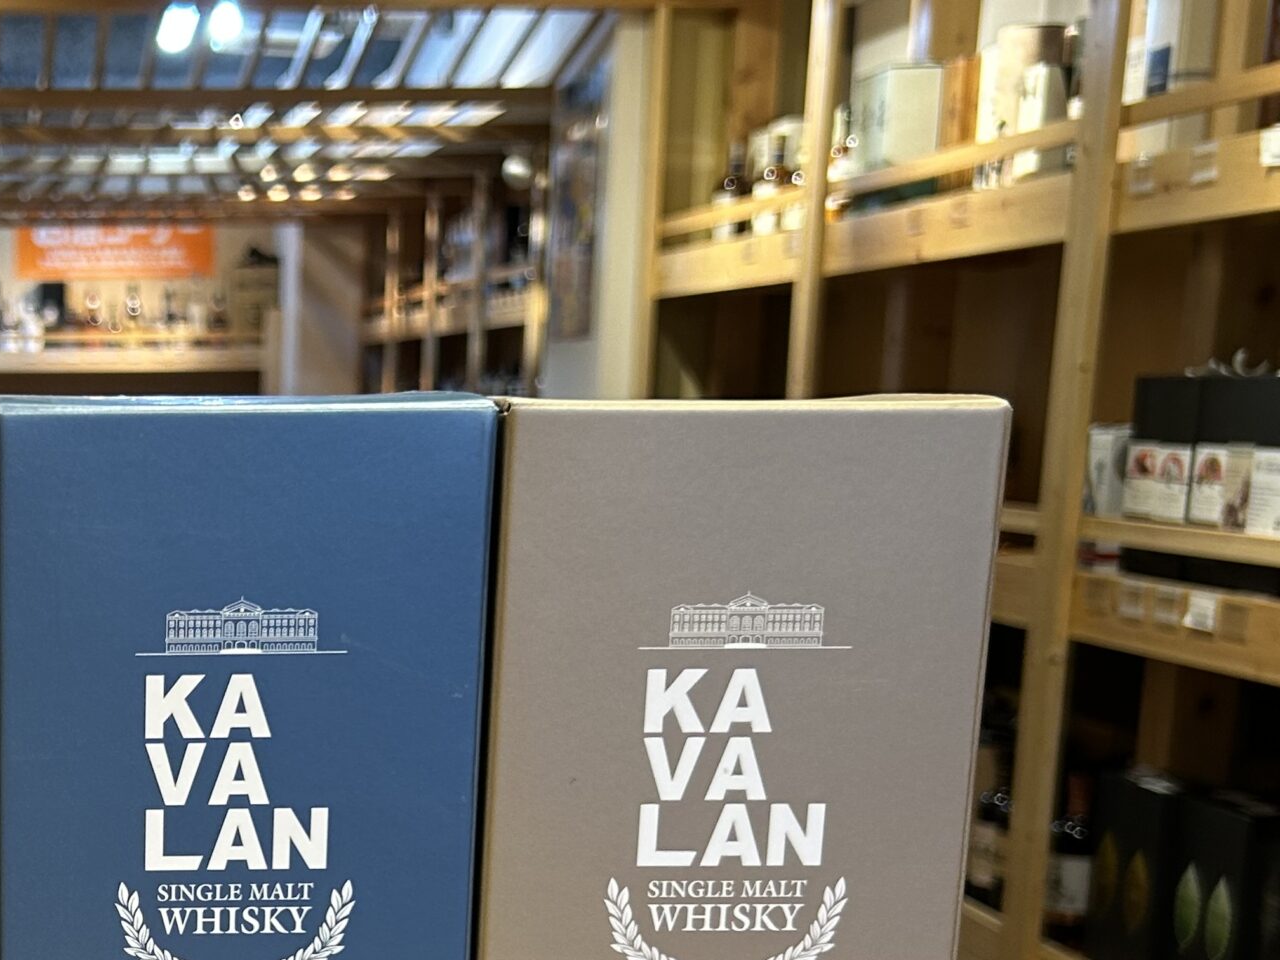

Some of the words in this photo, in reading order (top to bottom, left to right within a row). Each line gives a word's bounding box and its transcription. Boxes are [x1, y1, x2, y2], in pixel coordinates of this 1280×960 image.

[144, 673, 272, 739] KA
[643, 668, 772, 733] KA
[144, 742, 270, 806] VA
[643, 736, 767, 800] VA
[144, 807, 329, 871] LAN
[636, 803, 826, 867] LAN
[157, 884, 243, 902] SINGLE
[248, 882, 314, 901] MALT
[157, 905, 313, 935] WHISKY
[647, 880, 735, 898] SINGLE
[740, 879, 807, 898] MALT
[648, 903, 805, 932] WHISKY
